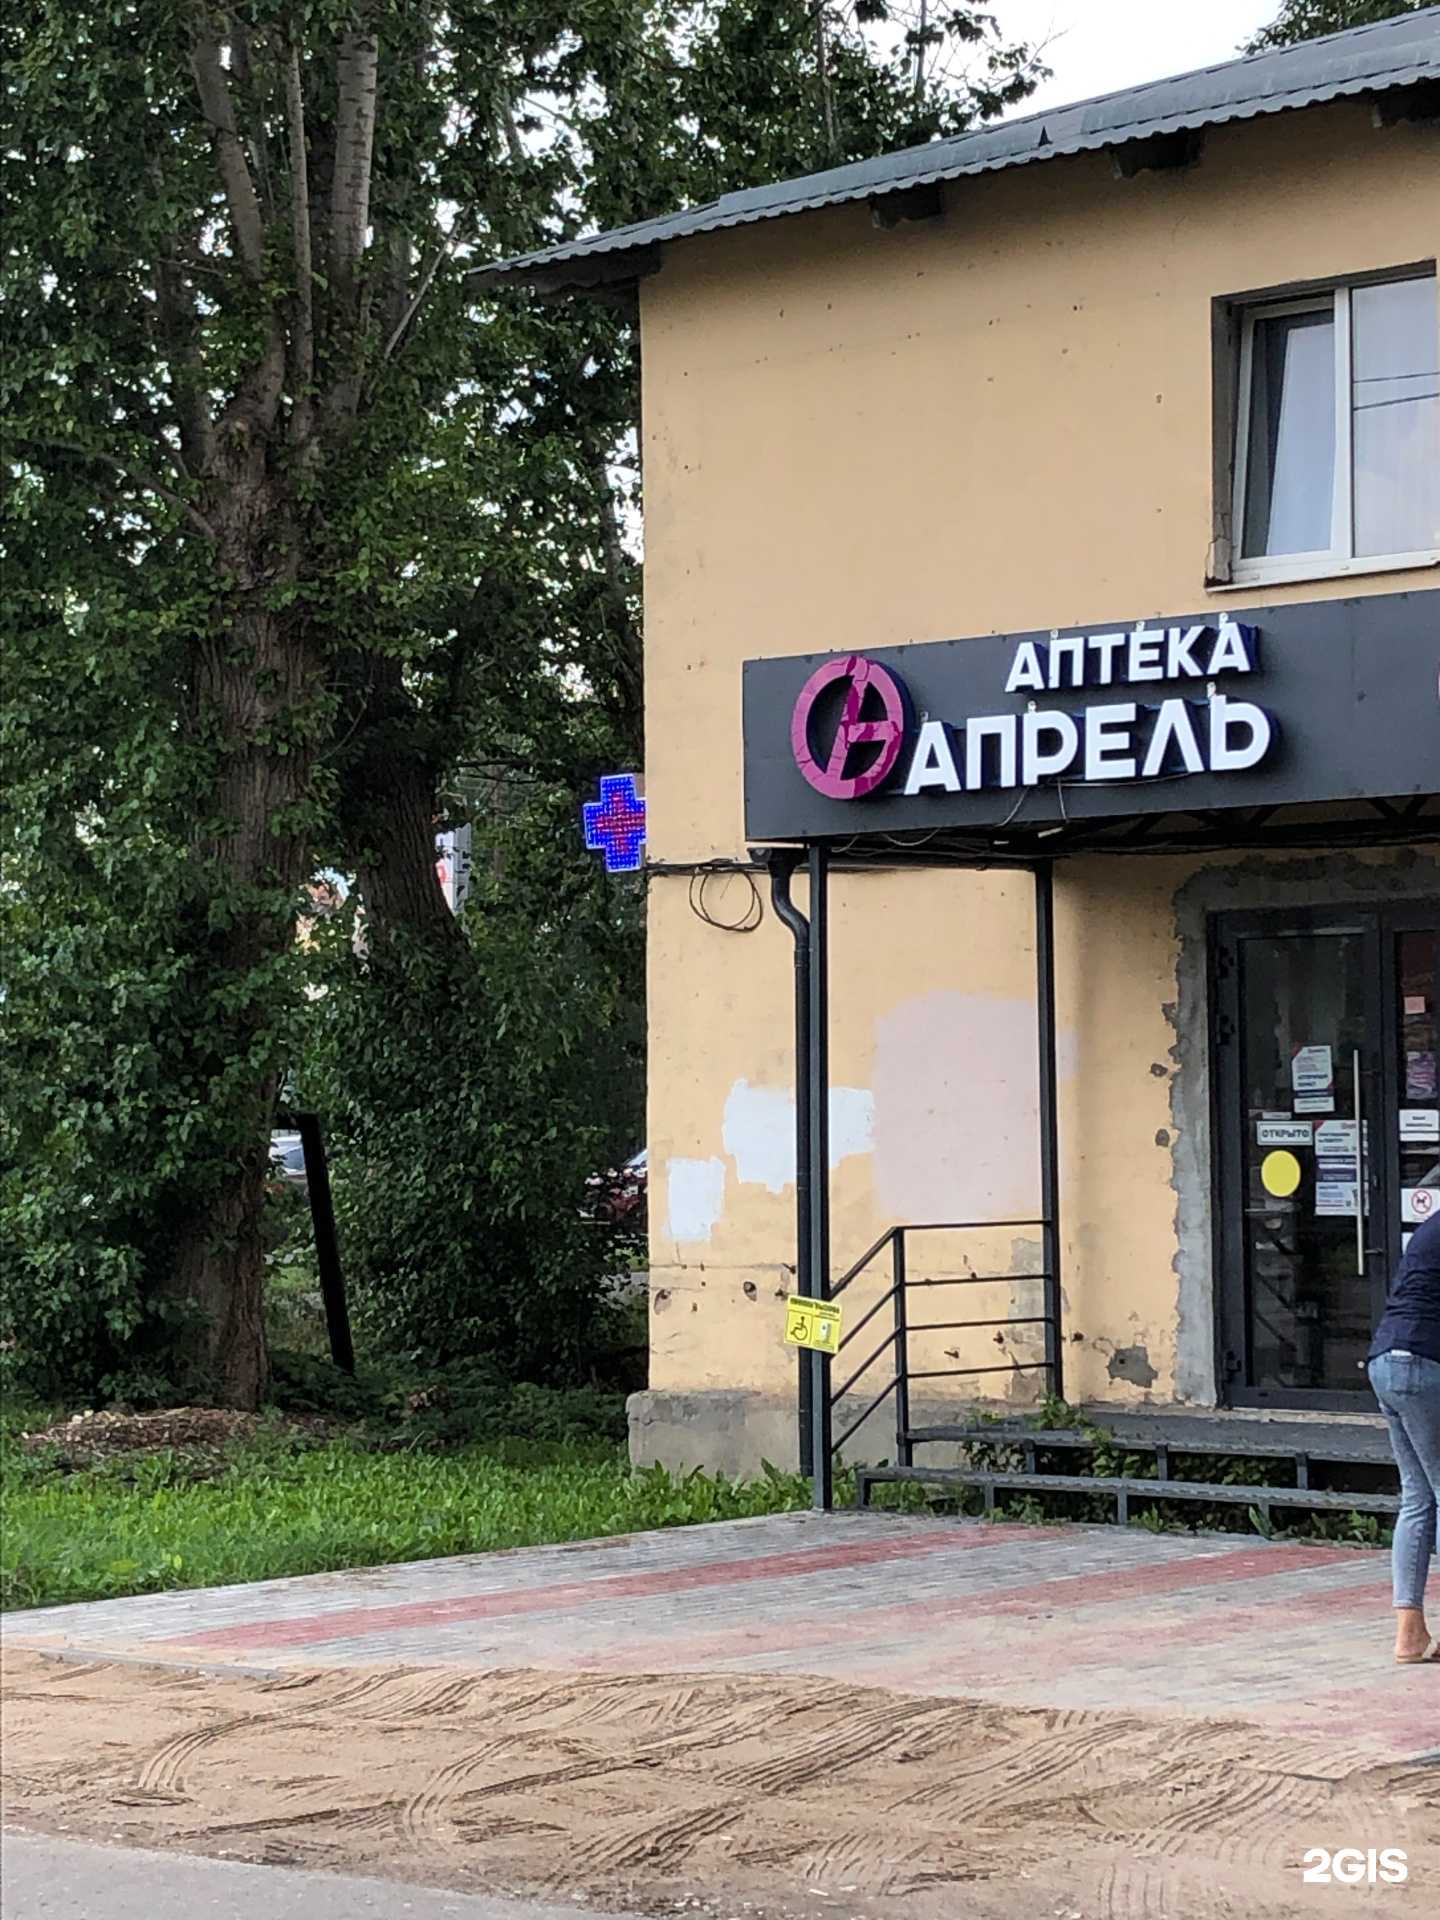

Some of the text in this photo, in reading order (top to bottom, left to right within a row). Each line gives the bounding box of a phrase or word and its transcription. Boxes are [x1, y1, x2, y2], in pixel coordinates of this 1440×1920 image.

[1004, 621, 1251, 693] АПТЕКА
[904, 695, 1271, 795] АПРЕЛЬ
[1262, 1128, 1310, 1139] ОТКРЫТО
